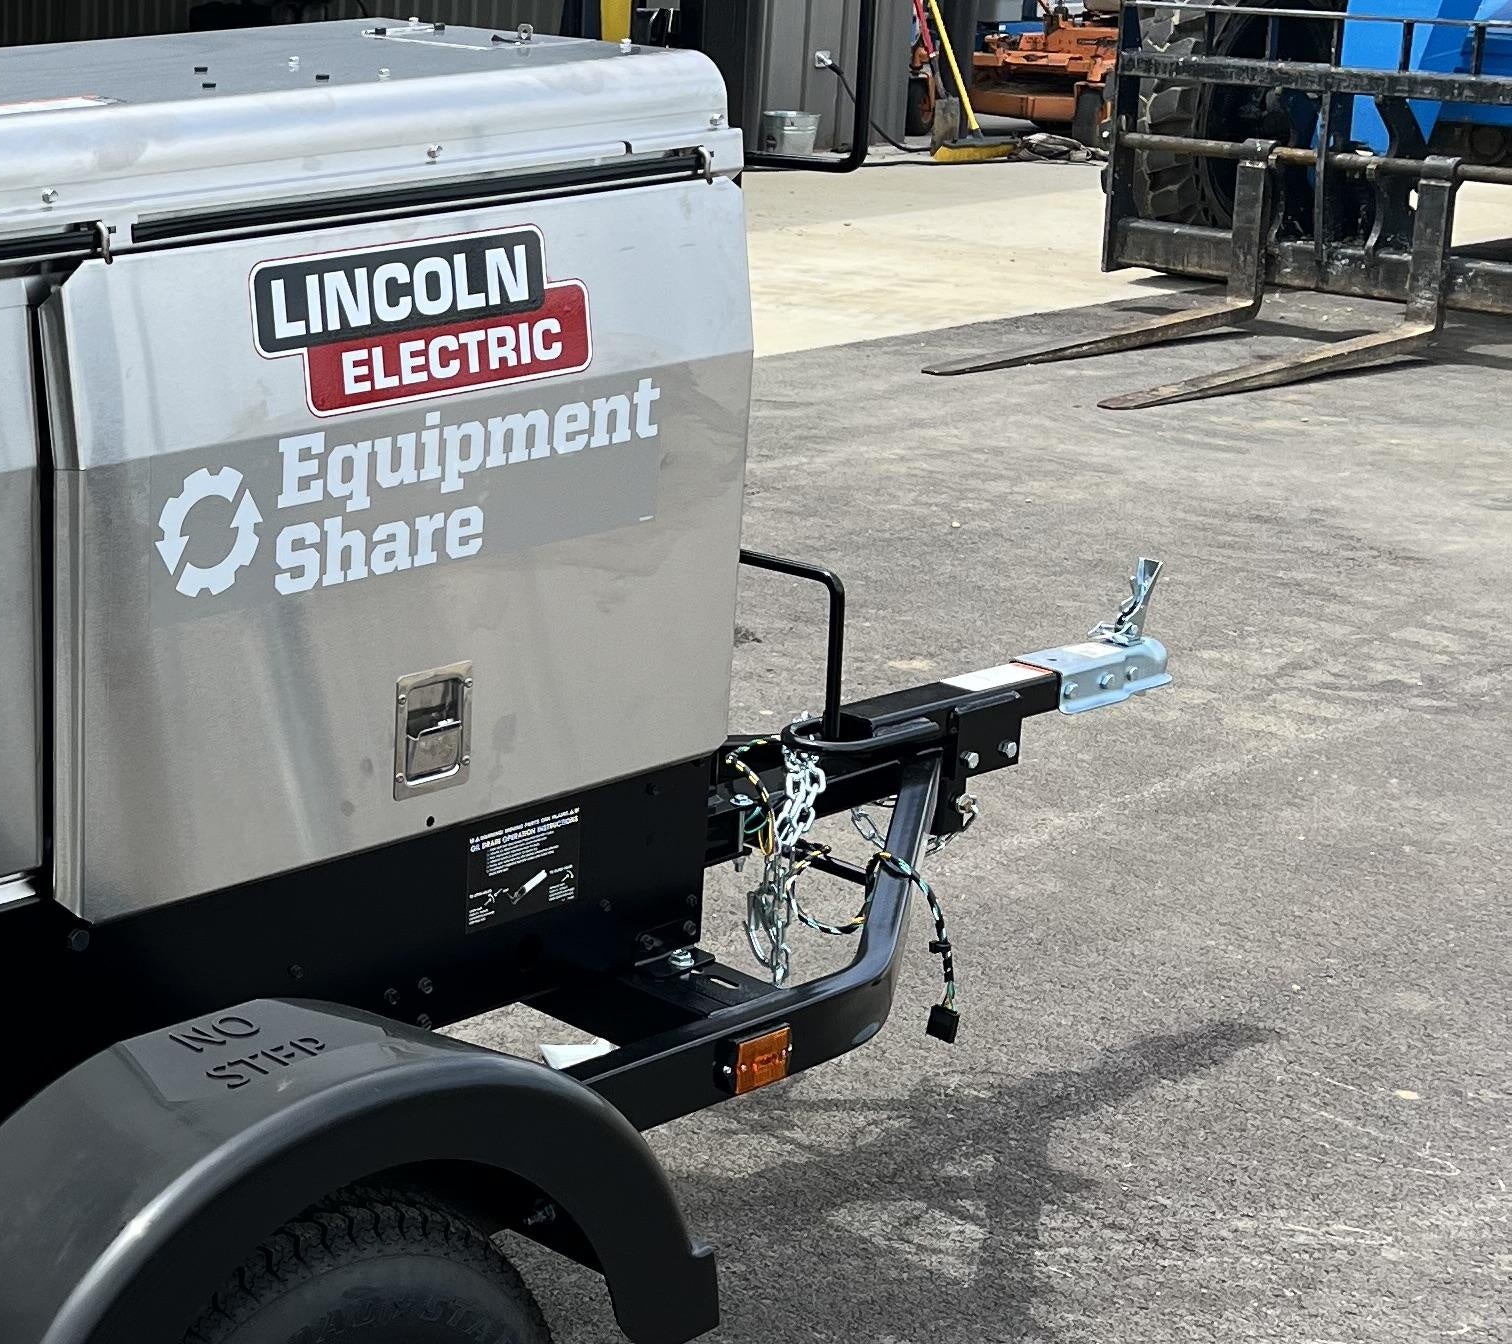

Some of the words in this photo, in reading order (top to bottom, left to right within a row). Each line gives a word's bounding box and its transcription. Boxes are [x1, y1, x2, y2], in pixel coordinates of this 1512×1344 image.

[271, 244, 531, 340] LINCOLN
[341, 317, 563, 396] ELECTRIC
[276, 377, 661, 513] Equipment
[274, 505, 484, 597] Share
[168, 1016, 260, 1053] NO
